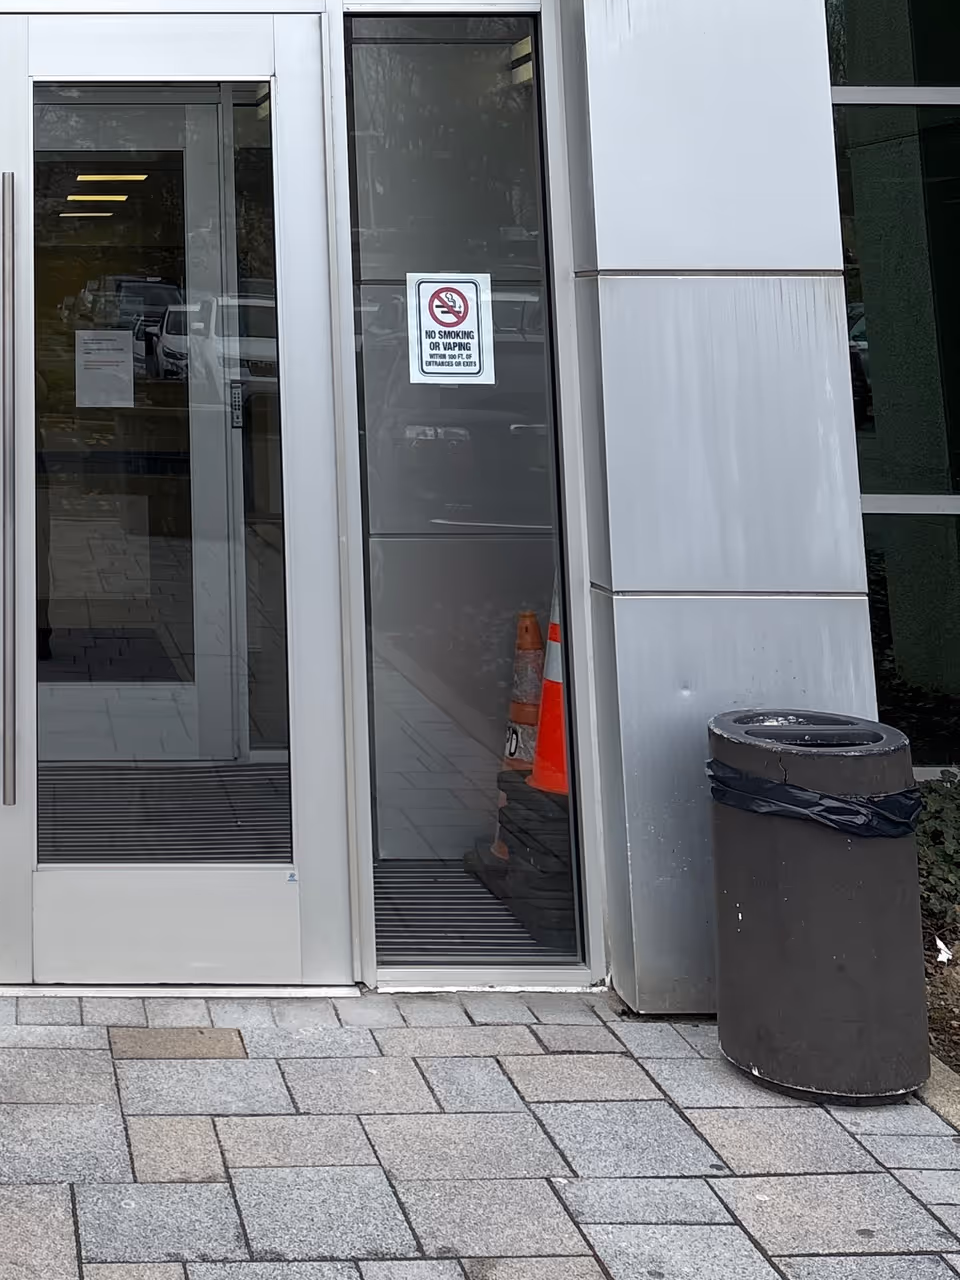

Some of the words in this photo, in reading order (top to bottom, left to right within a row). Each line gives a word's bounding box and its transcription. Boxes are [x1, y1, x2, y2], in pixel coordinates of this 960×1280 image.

[425, 330, 436, 339] NO
[438, 330, 474, 339] SMOKING
[429, 342, 440, 351] OR
[442, 342, 471, 351] VAPING
